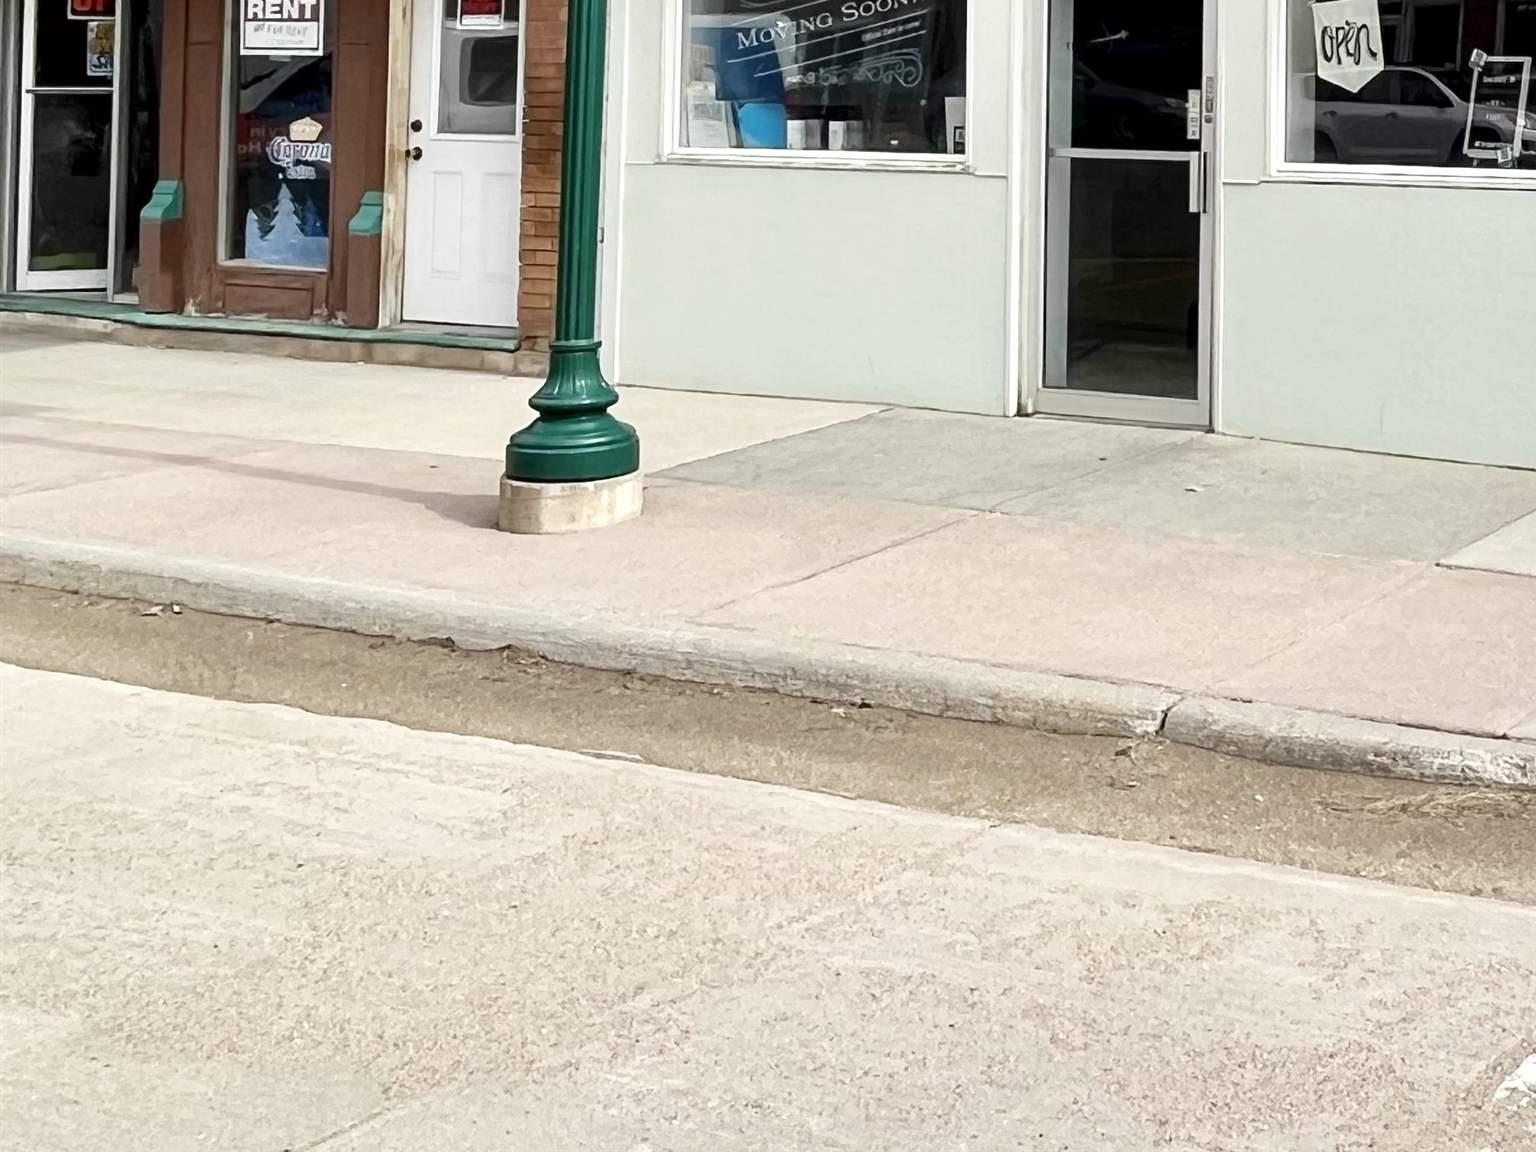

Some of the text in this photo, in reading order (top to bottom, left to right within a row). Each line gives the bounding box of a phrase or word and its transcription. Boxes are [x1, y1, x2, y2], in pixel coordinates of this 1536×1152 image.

[247, 0, 317, 19] RENT
[736, 12, 833, 50] MOVING
[266, 136, 332, 168] Corona
